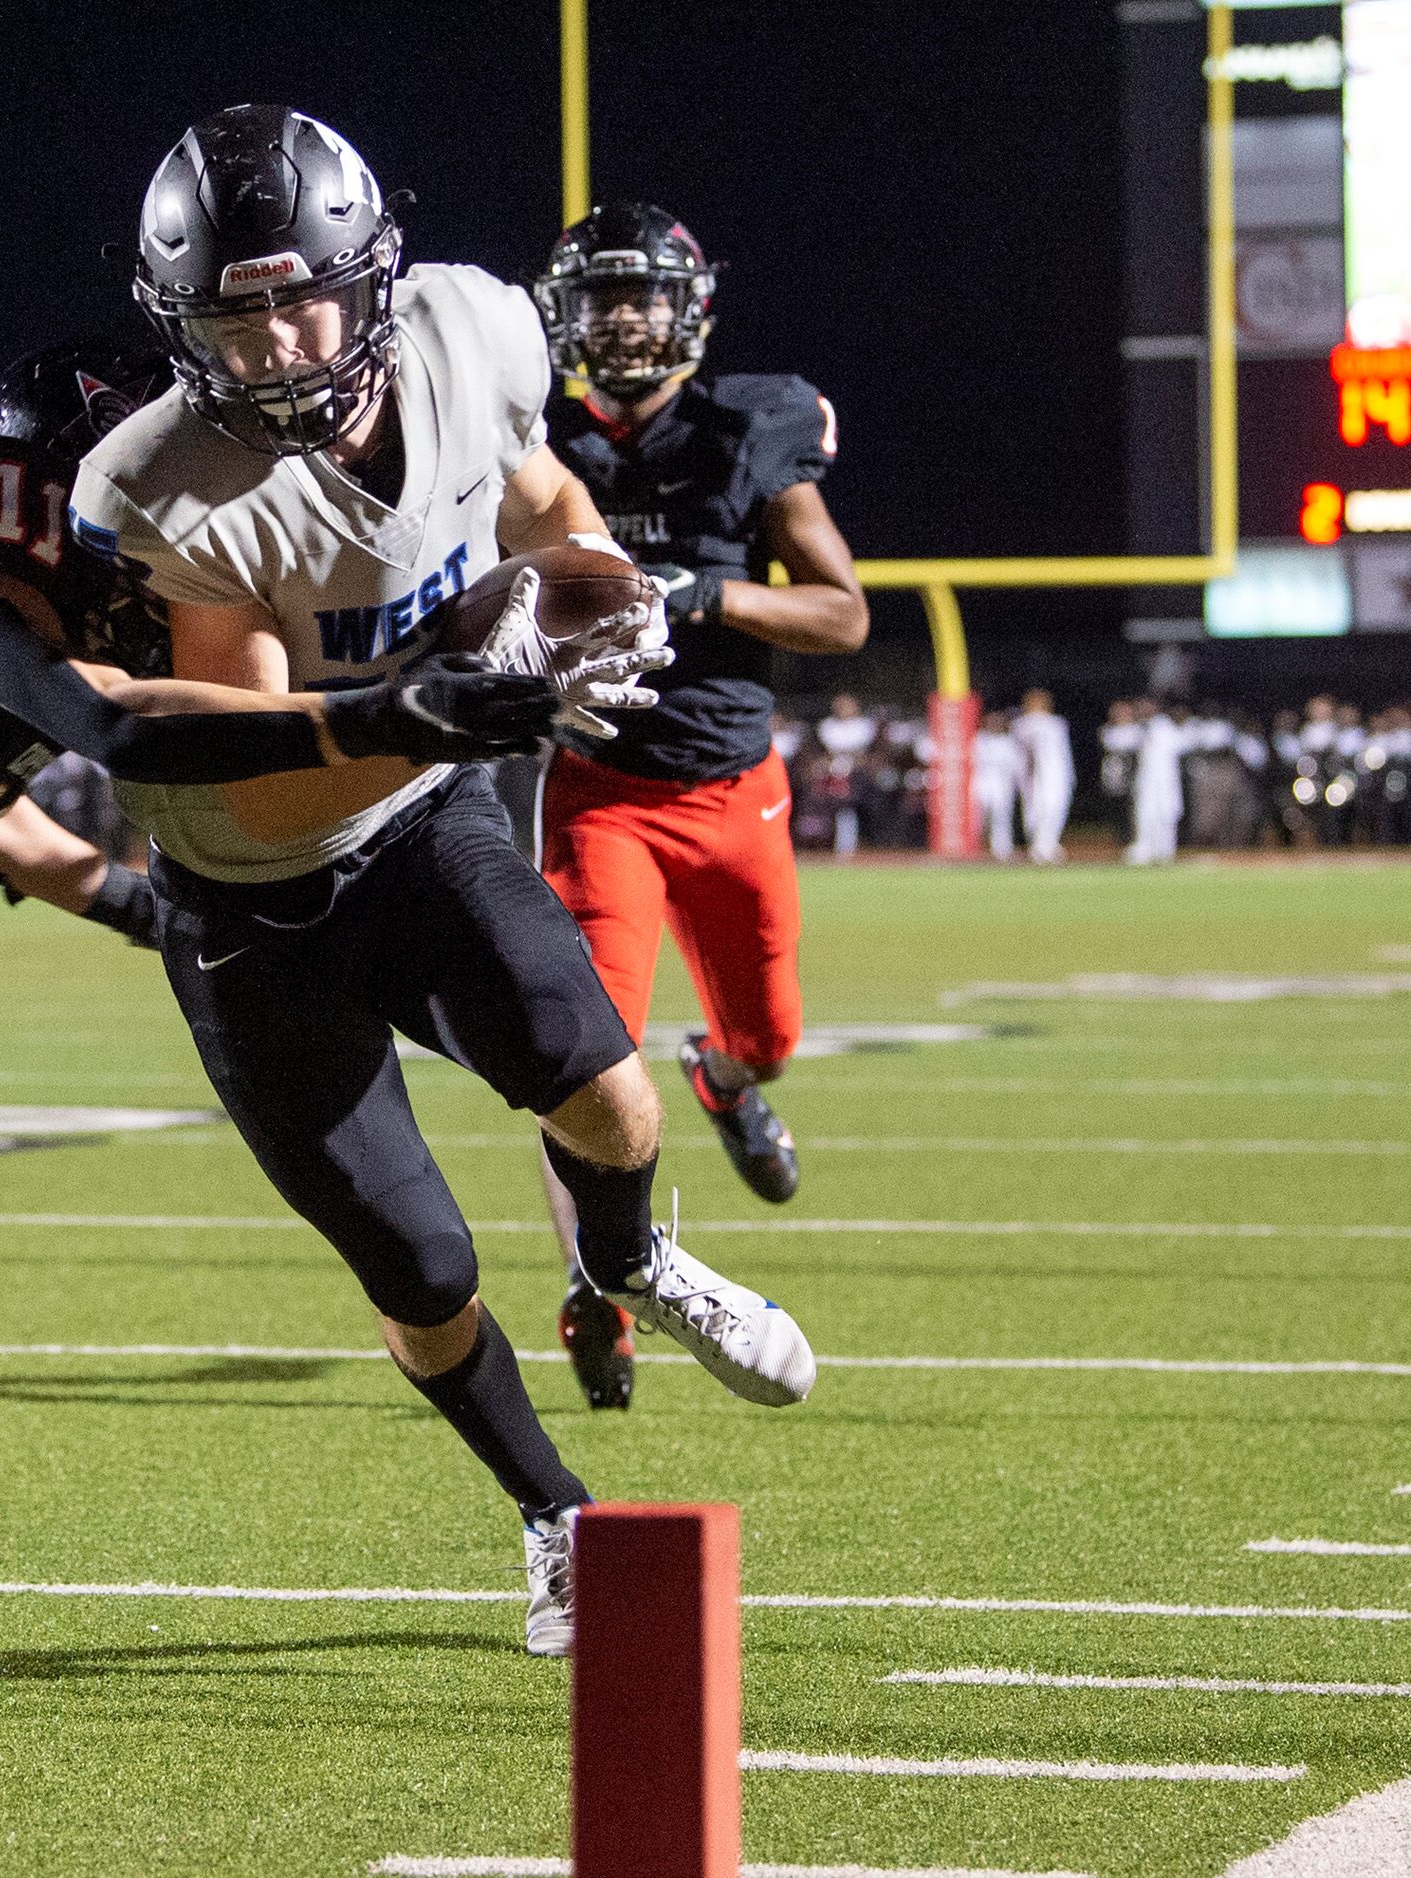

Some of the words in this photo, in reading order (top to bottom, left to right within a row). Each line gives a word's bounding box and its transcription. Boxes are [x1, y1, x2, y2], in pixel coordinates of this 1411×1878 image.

[229, 258, 295, 282] Riddell
[605, 513, 670, 543] PPELL
[313, 541, 469, 665] WEST
